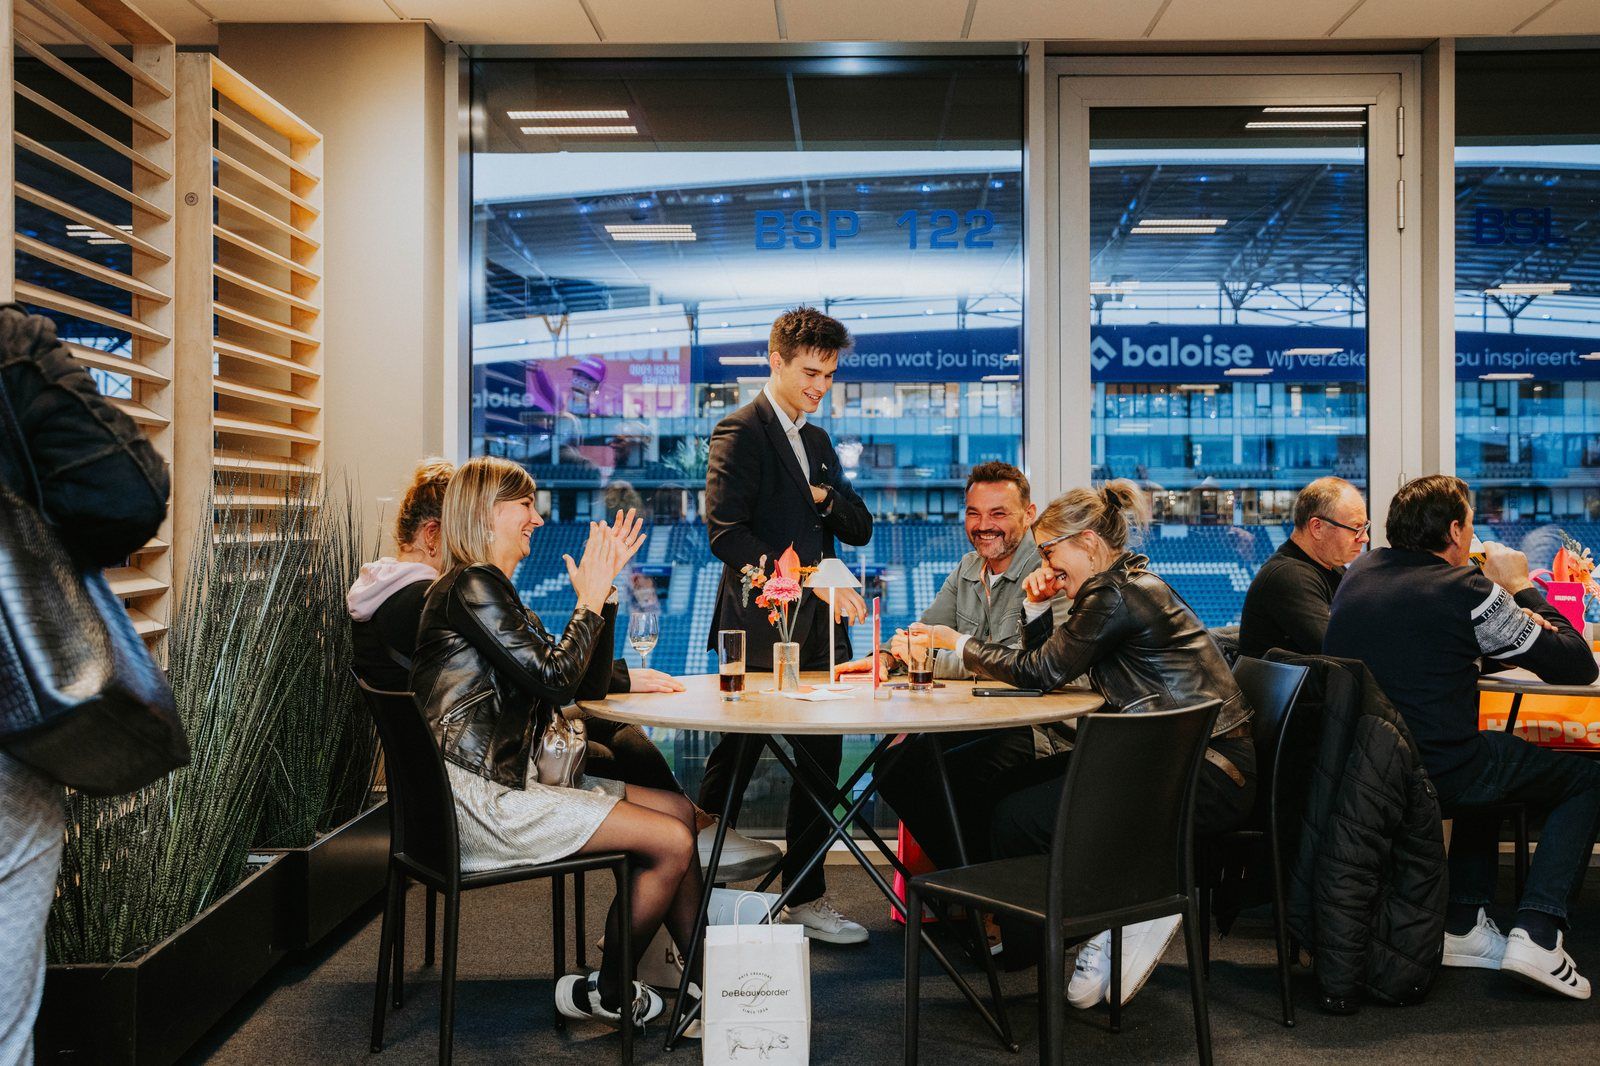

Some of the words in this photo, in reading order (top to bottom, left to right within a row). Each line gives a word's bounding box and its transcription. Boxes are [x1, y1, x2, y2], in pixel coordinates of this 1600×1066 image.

[755, 210, 860, 249] BSP
[896, 209, 996, 249] 122
[1476, 207, 1569, 245] BSL
[895, 350, 934, 367] wat
[936, 349, 967, 370] jou
[1122, 335, 1254, 367] baloise
